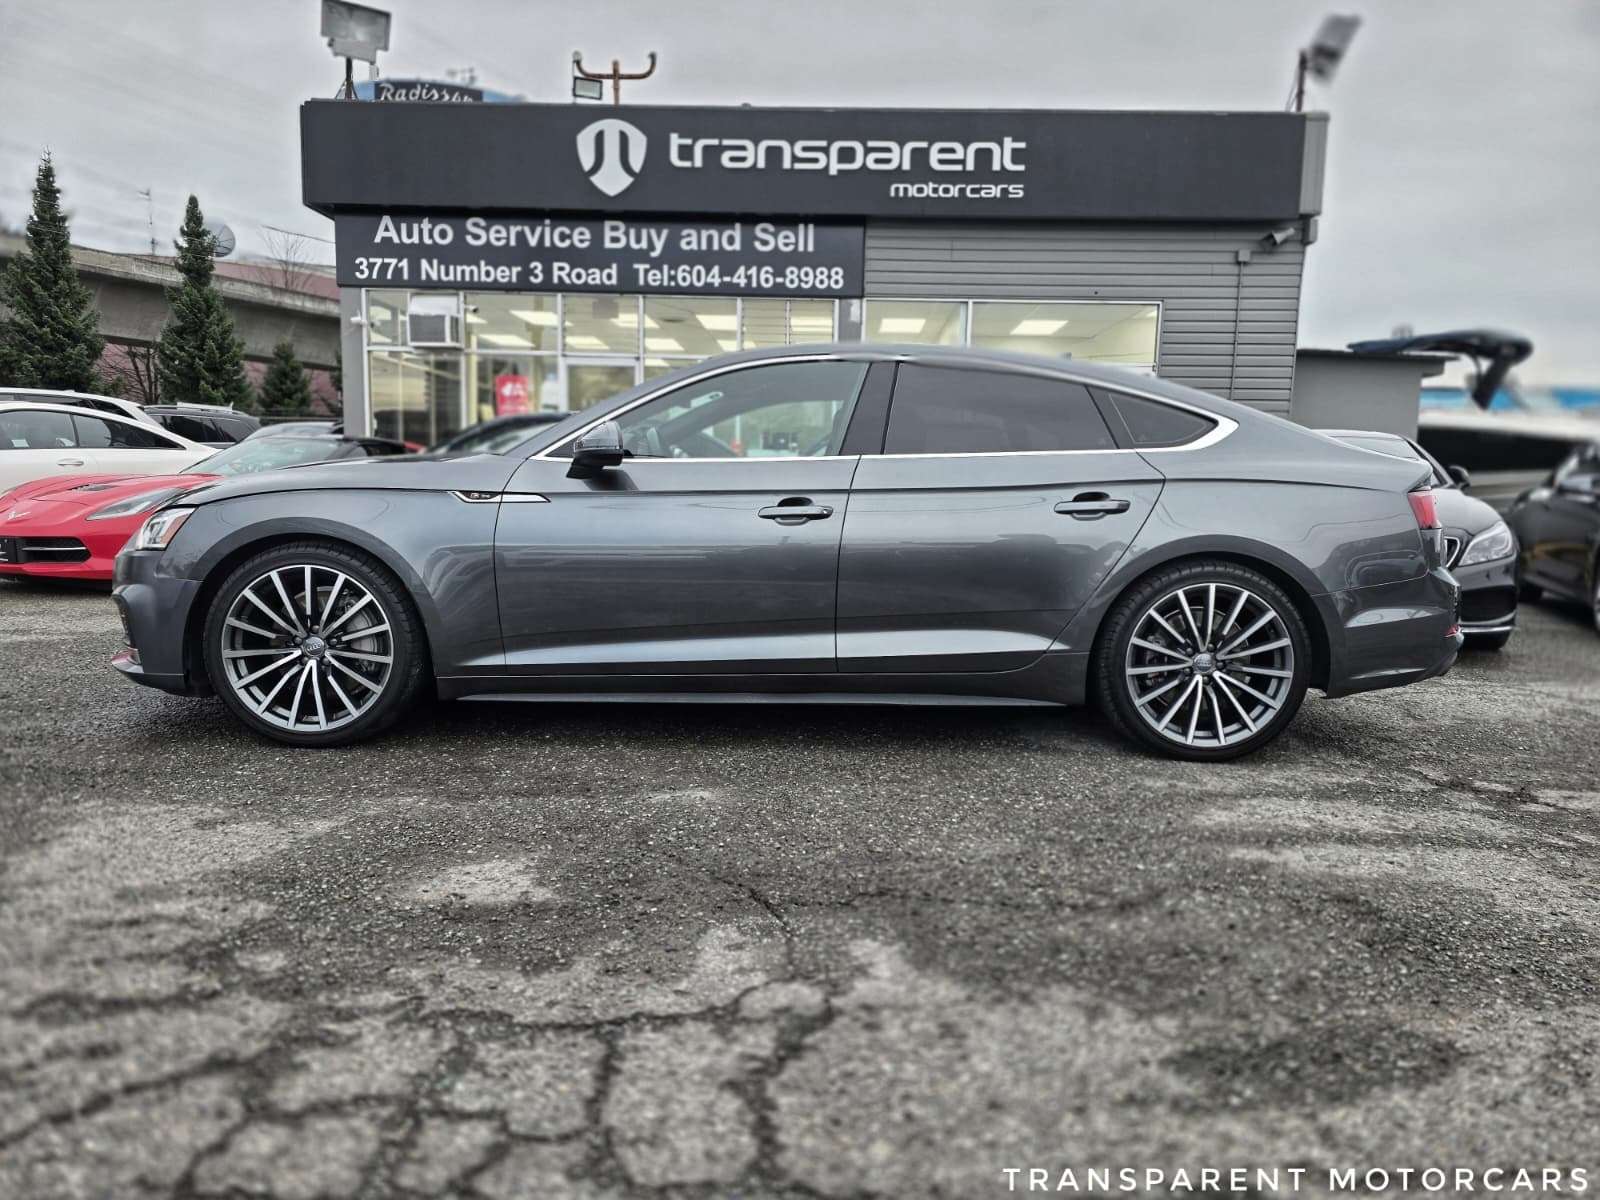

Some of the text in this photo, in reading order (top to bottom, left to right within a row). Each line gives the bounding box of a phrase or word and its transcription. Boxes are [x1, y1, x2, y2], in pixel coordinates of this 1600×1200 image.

[669, 132, 1026, 176] transparent
[890, 181, 1025, 199] motorcars
[374, 216, 815, 257] Auto Service Buy and Sell
[355, 257, 845, 290] 3771 Number 3 Road Tel:604-416-8988
